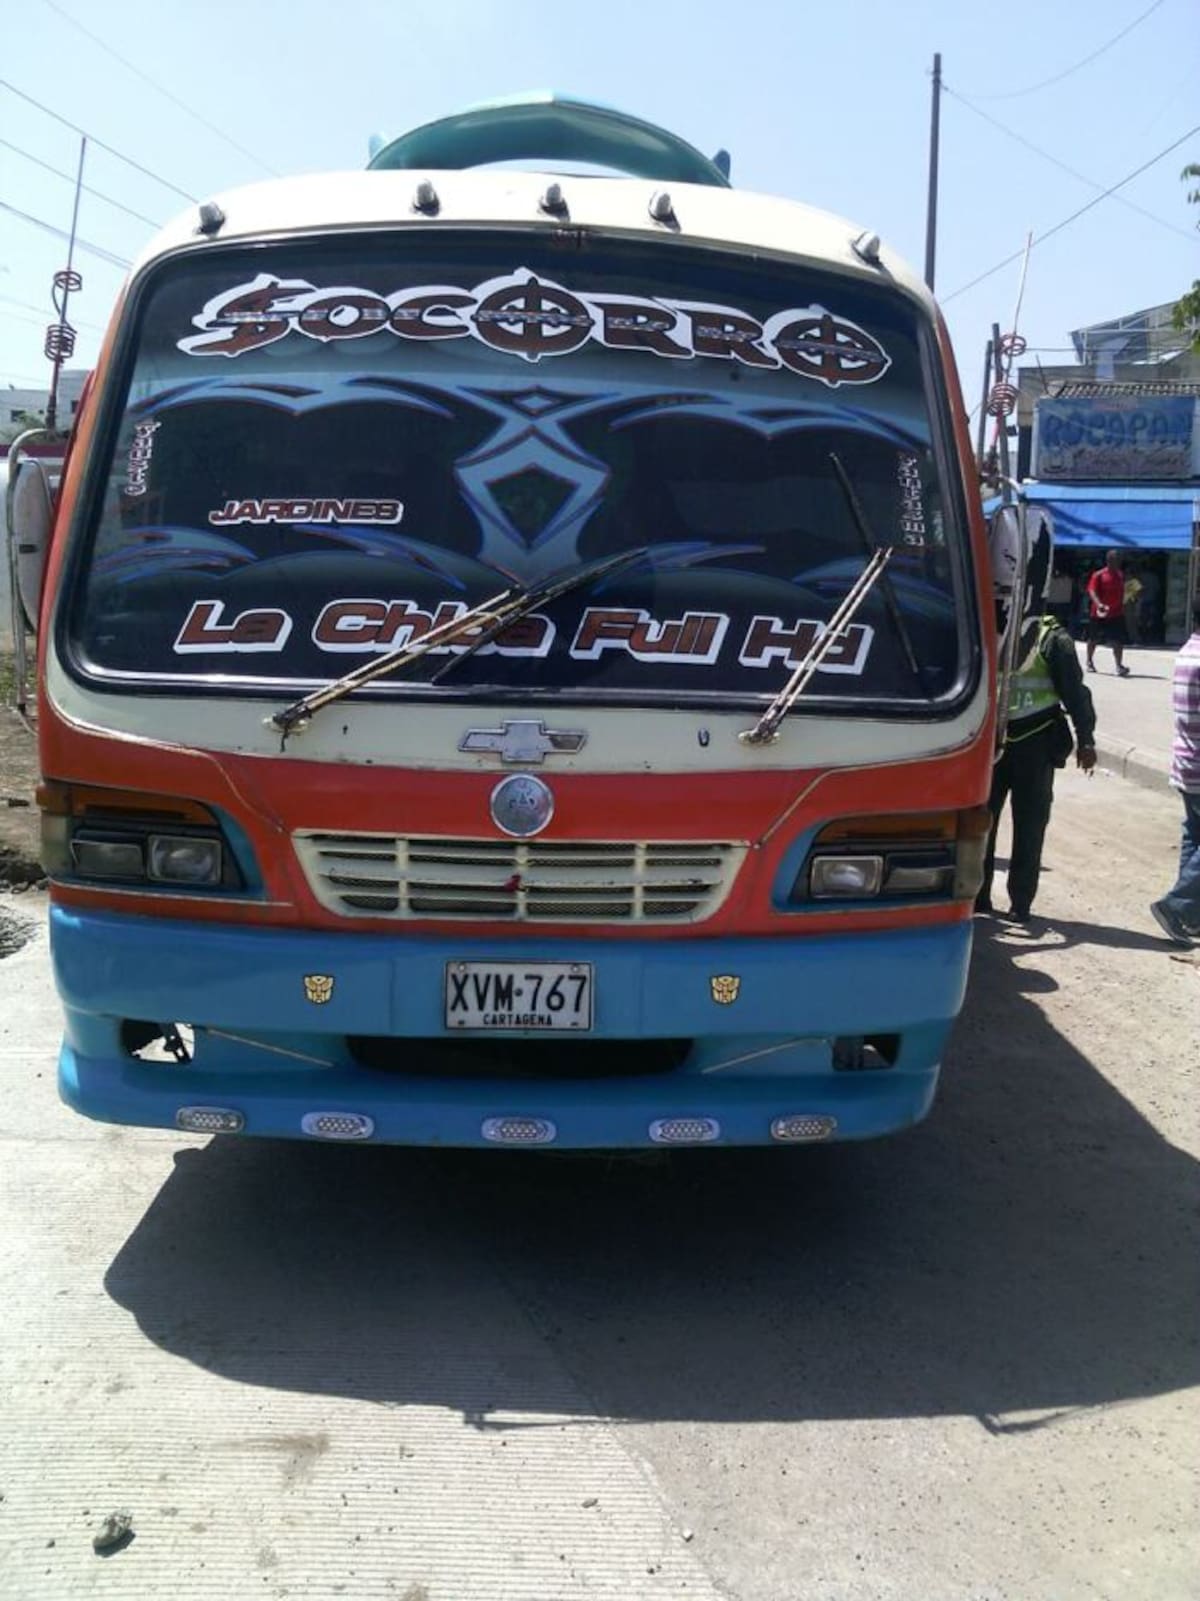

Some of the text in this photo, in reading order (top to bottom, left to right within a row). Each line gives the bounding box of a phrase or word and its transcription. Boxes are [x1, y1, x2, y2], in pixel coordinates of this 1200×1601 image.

[176, 267, 892, 387] SOCORRO
[208, 498, 404, 526] JARDINES
[173, 600, 293, 654] La
[569, 606, 731, 665] Full
[738, 614, 875, 675] Hd
[483, 1013, 553, 1026] CARTAGENA
